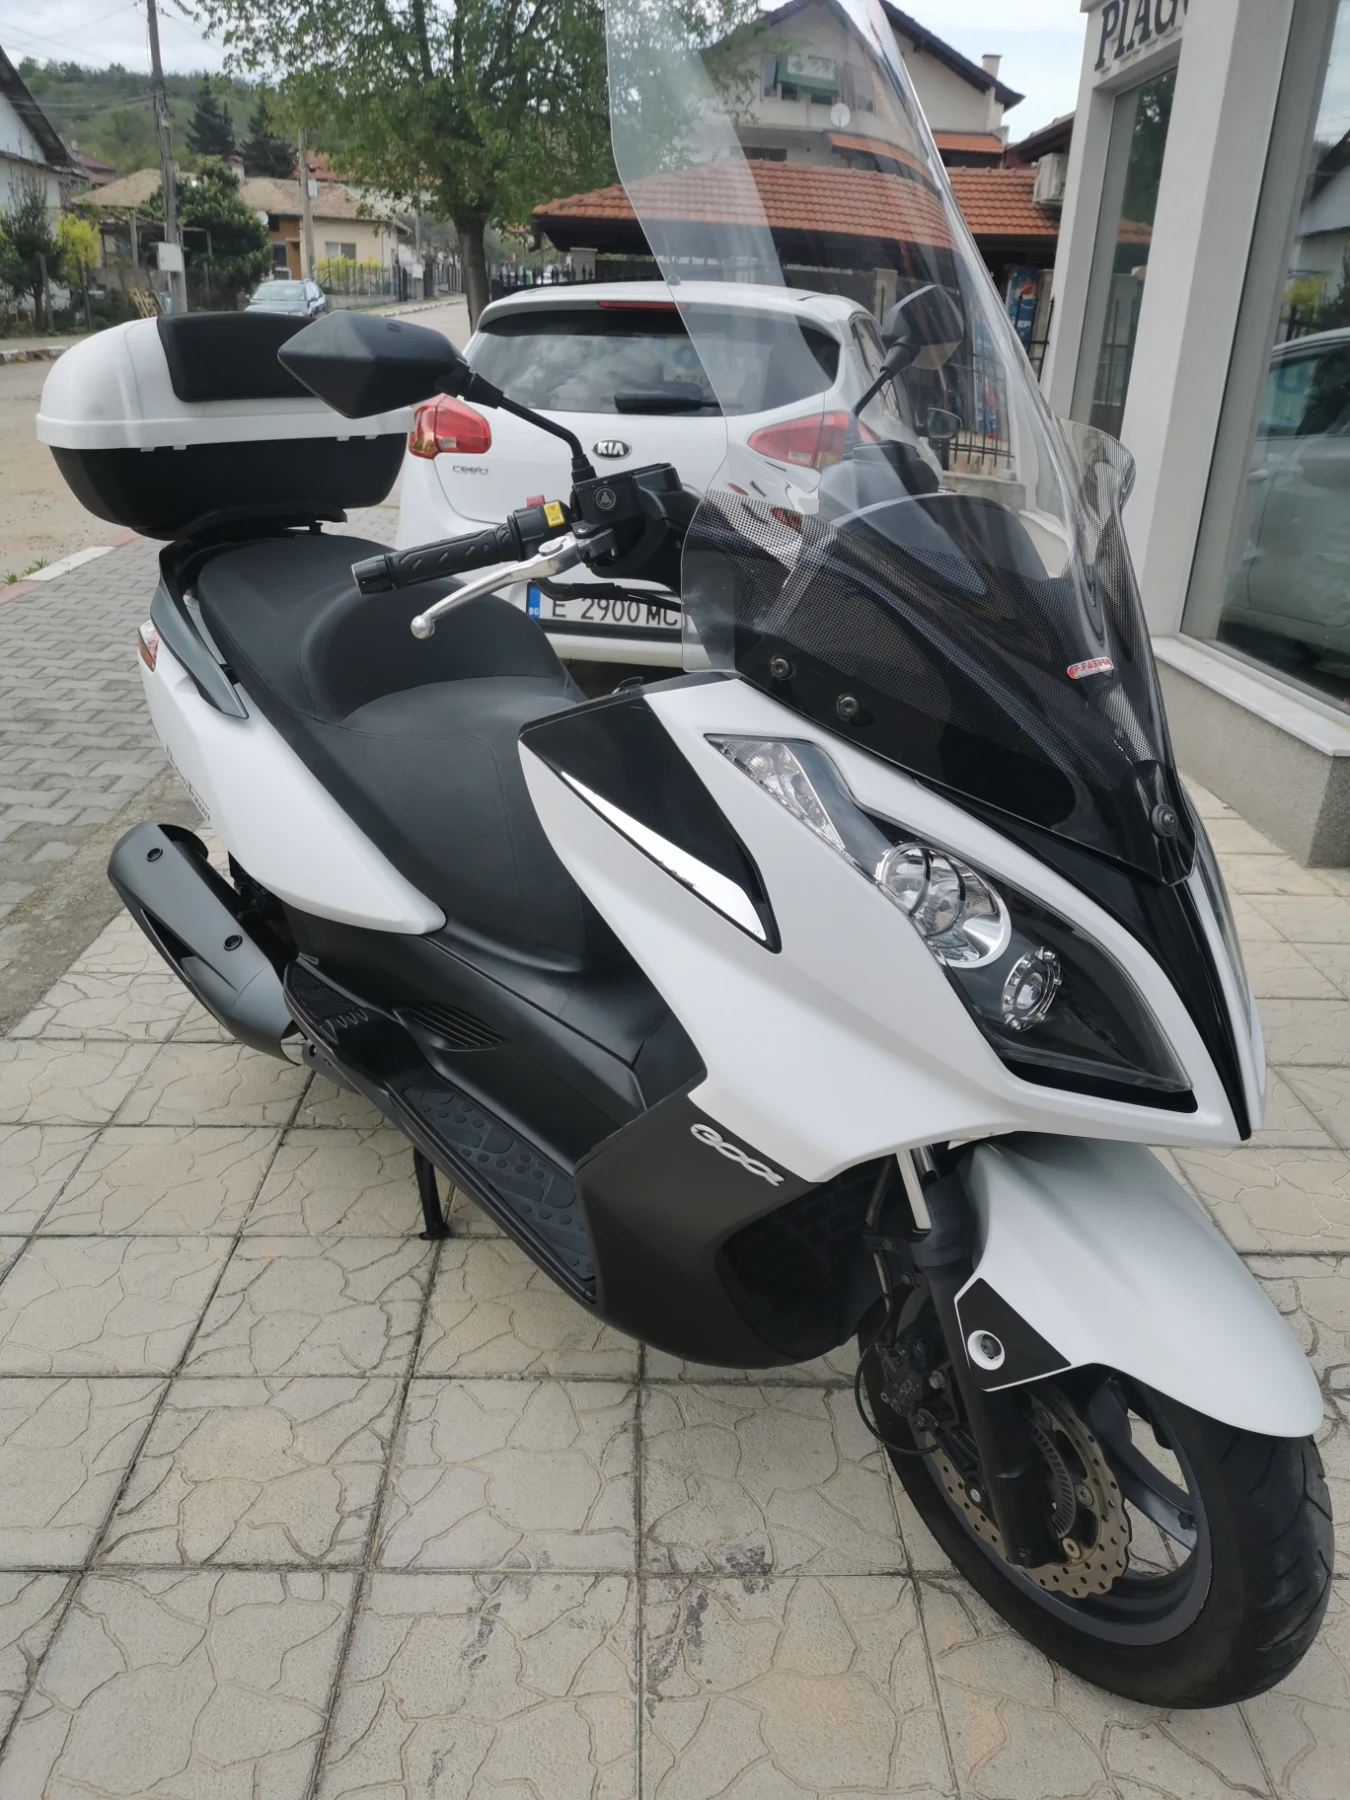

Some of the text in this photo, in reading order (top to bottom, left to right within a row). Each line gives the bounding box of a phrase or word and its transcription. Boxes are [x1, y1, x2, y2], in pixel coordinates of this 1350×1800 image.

[1094, 0, 1189, 72] PIAG
[597, 442, 625, 456] KIA
[528, 607, 540, 616] BG
[552, 600, 567, 618] E
[580, 597, 640, 623] 2900
